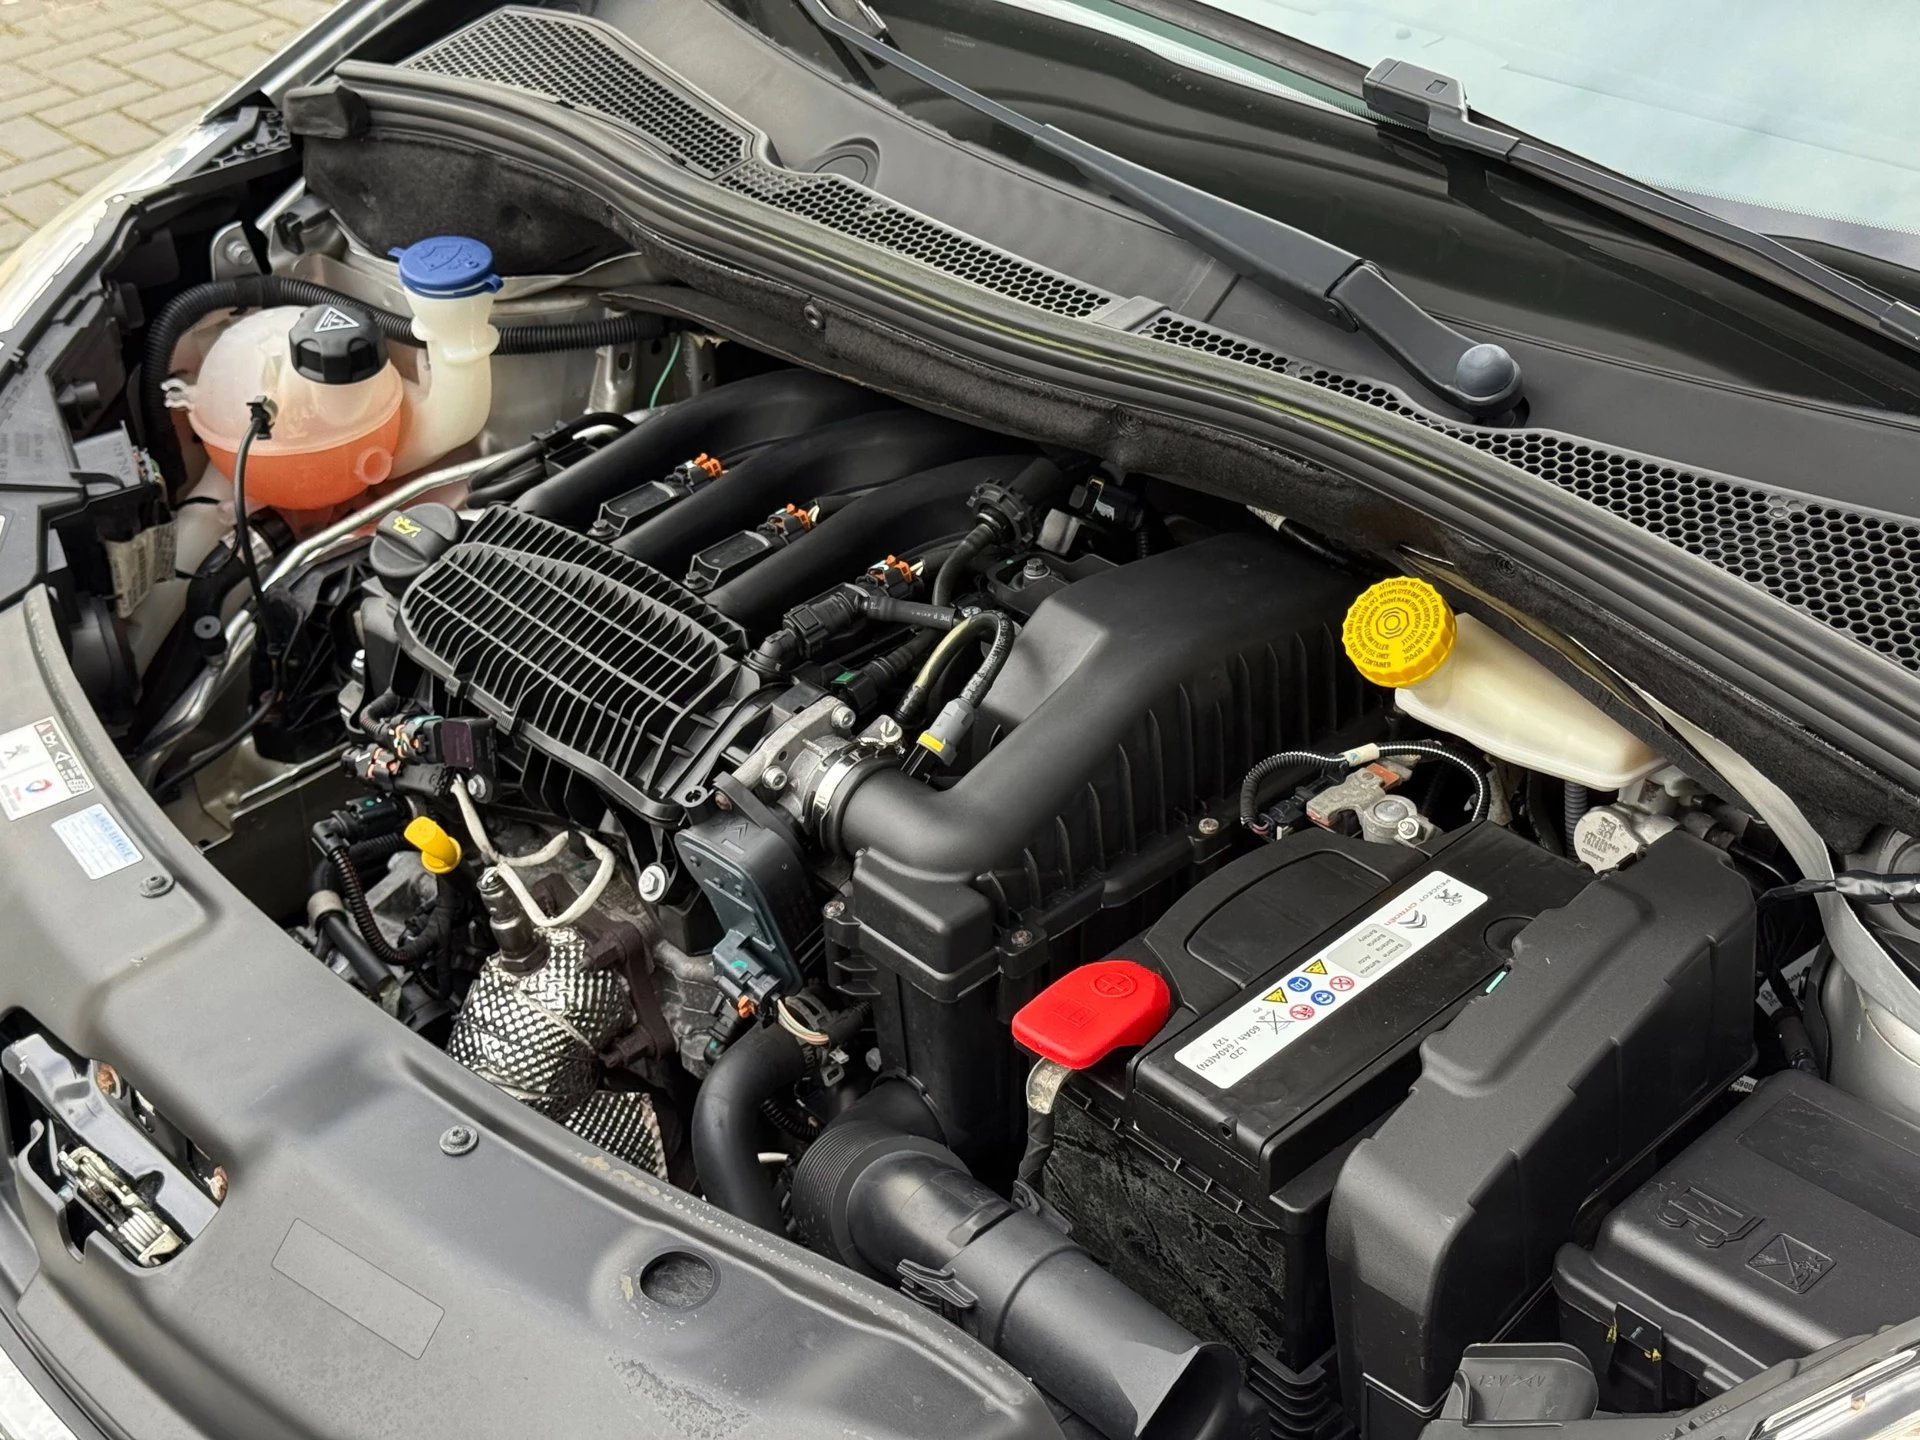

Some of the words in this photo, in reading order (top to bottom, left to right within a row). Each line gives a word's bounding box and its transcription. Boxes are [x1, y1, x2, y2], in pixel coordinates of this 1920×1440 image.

[1419, 879, 1451, 904] PEUGEOT
[1238, 1025, 1261, 1041] 60Ah
[1212, 1037, 1229, 1050] 12V
[1196, 1043, 1235, 1071] 640A(EN)
[1229, 1046, 1248, 1060] L2D
